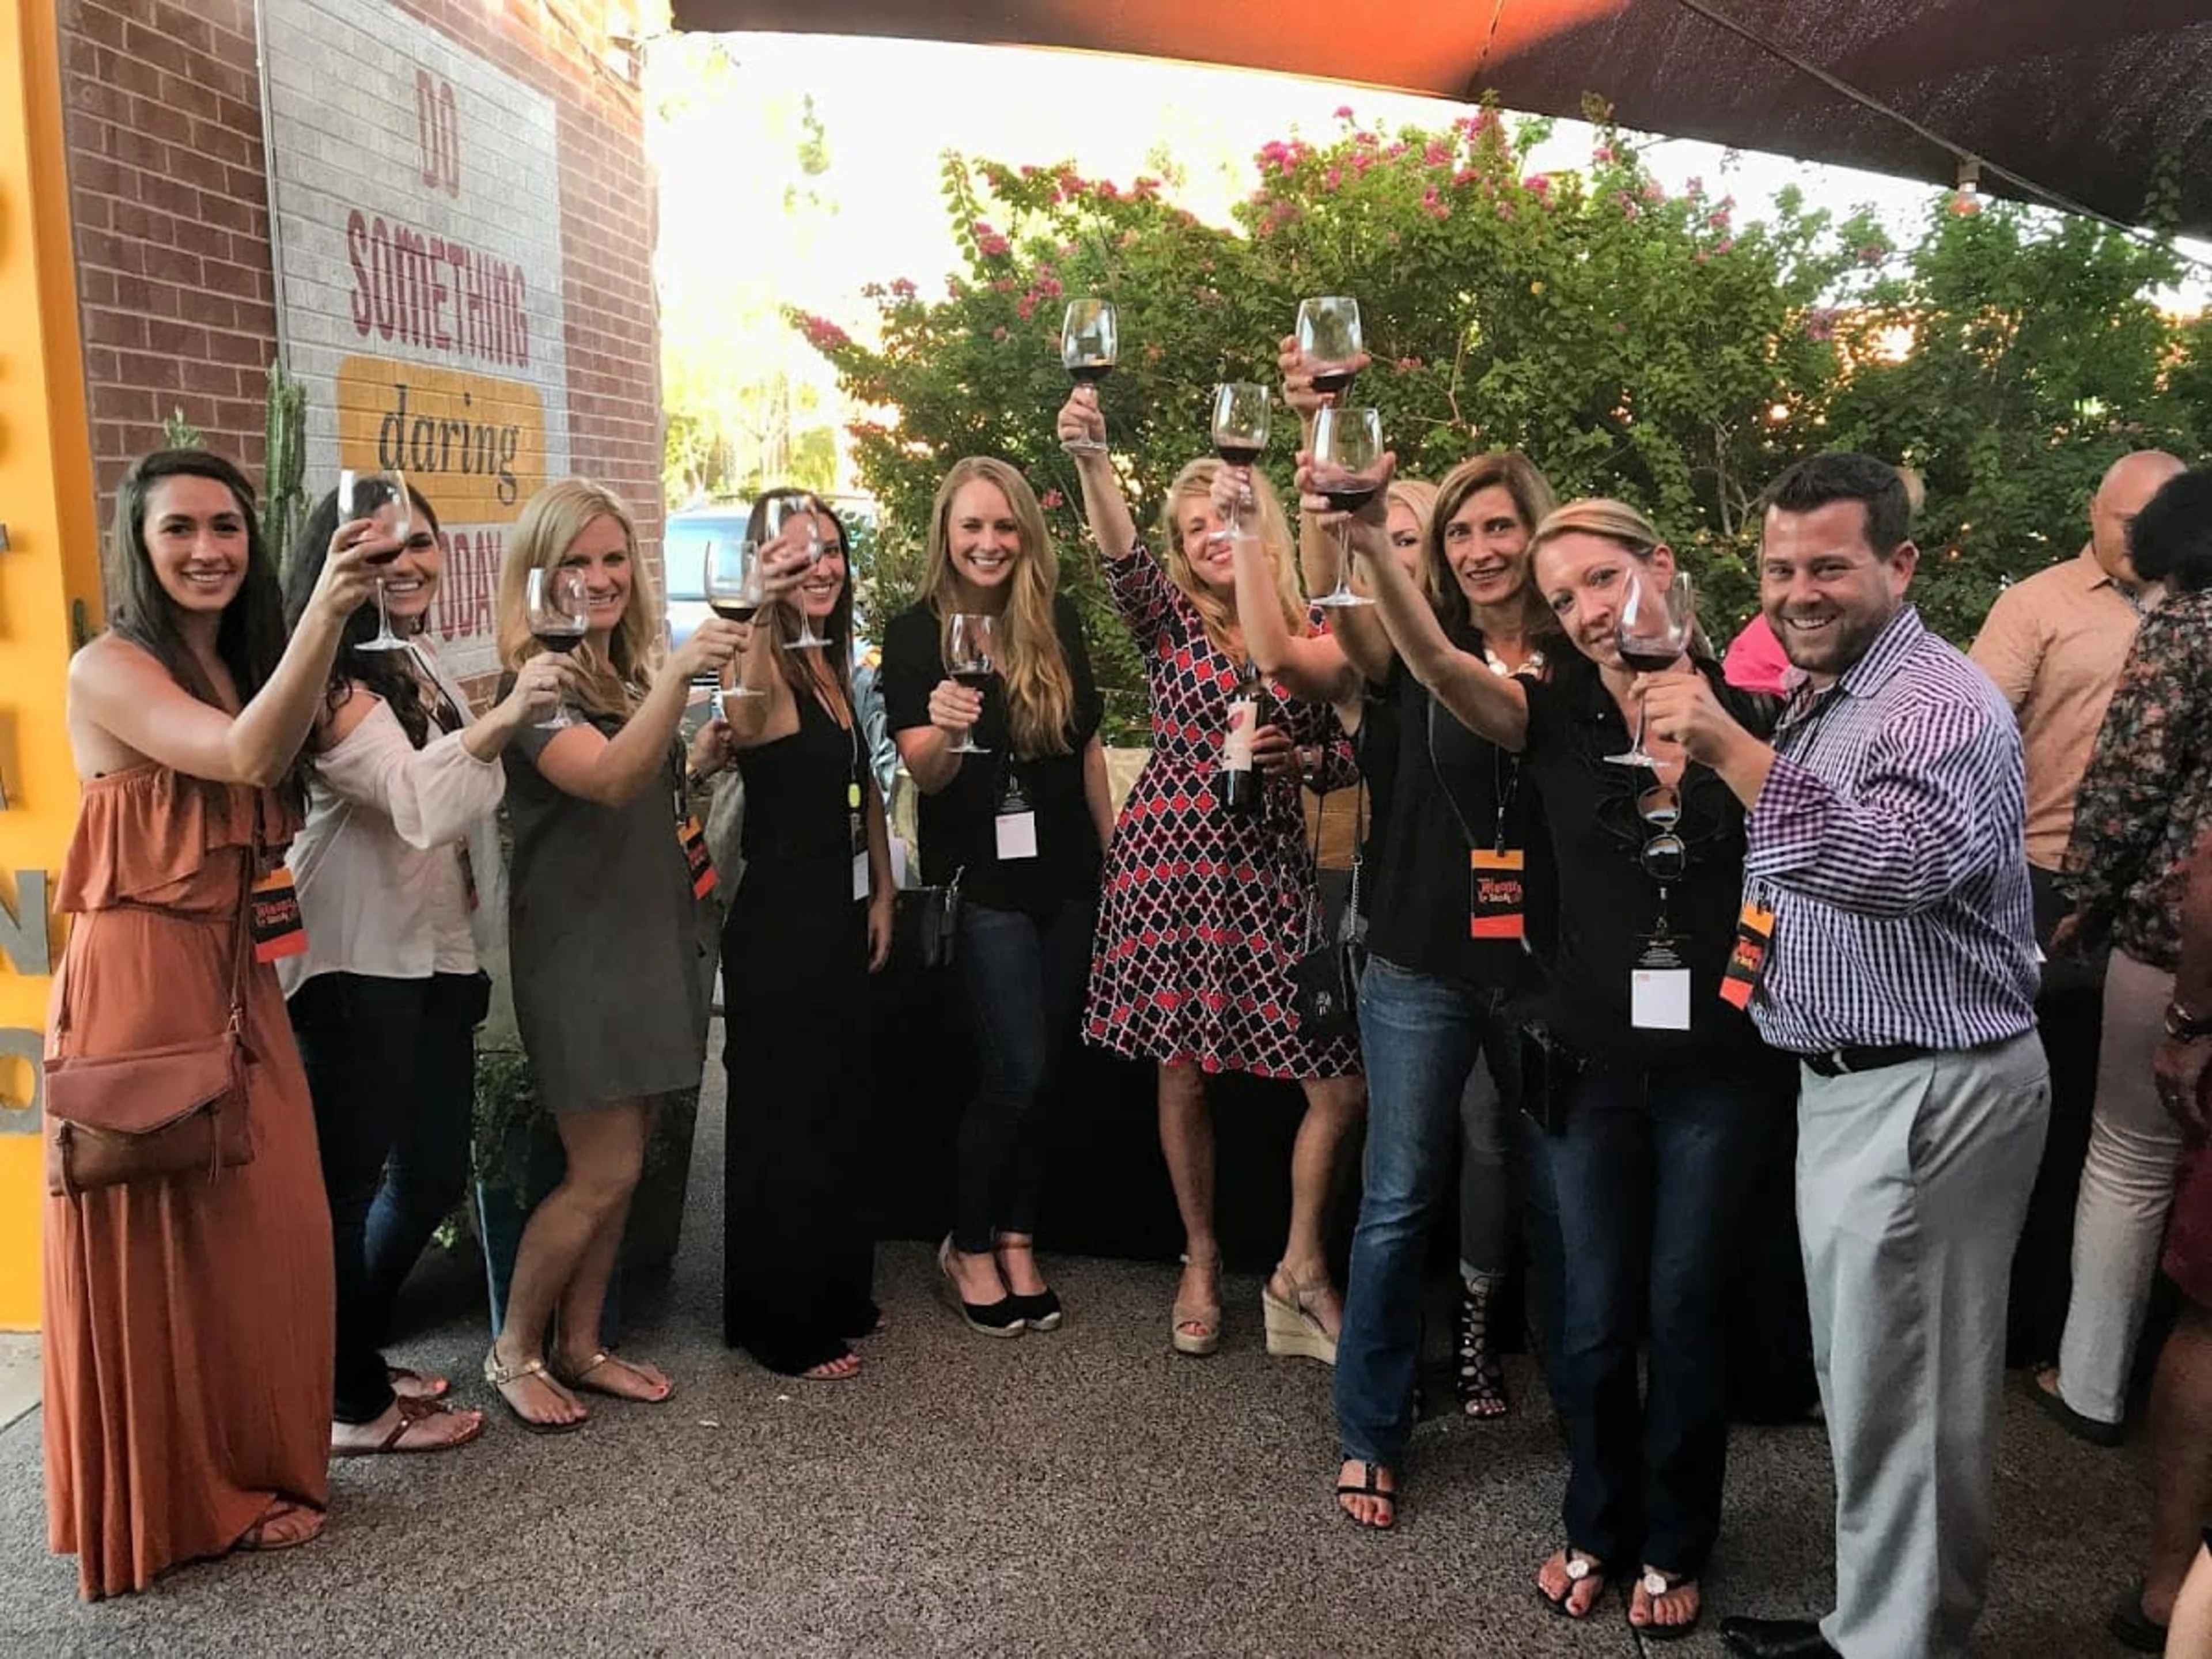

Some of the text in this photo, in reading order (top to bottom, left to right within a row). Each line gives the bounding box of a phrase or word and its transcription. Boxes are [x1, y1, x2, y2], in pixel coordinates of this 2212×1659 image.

[416, 69, 460, 199] DO
[347, 209, 529, 368] SOMETHING
[378, 383, 518, 506] daring
[425, 530, 502, 642] ODAY
